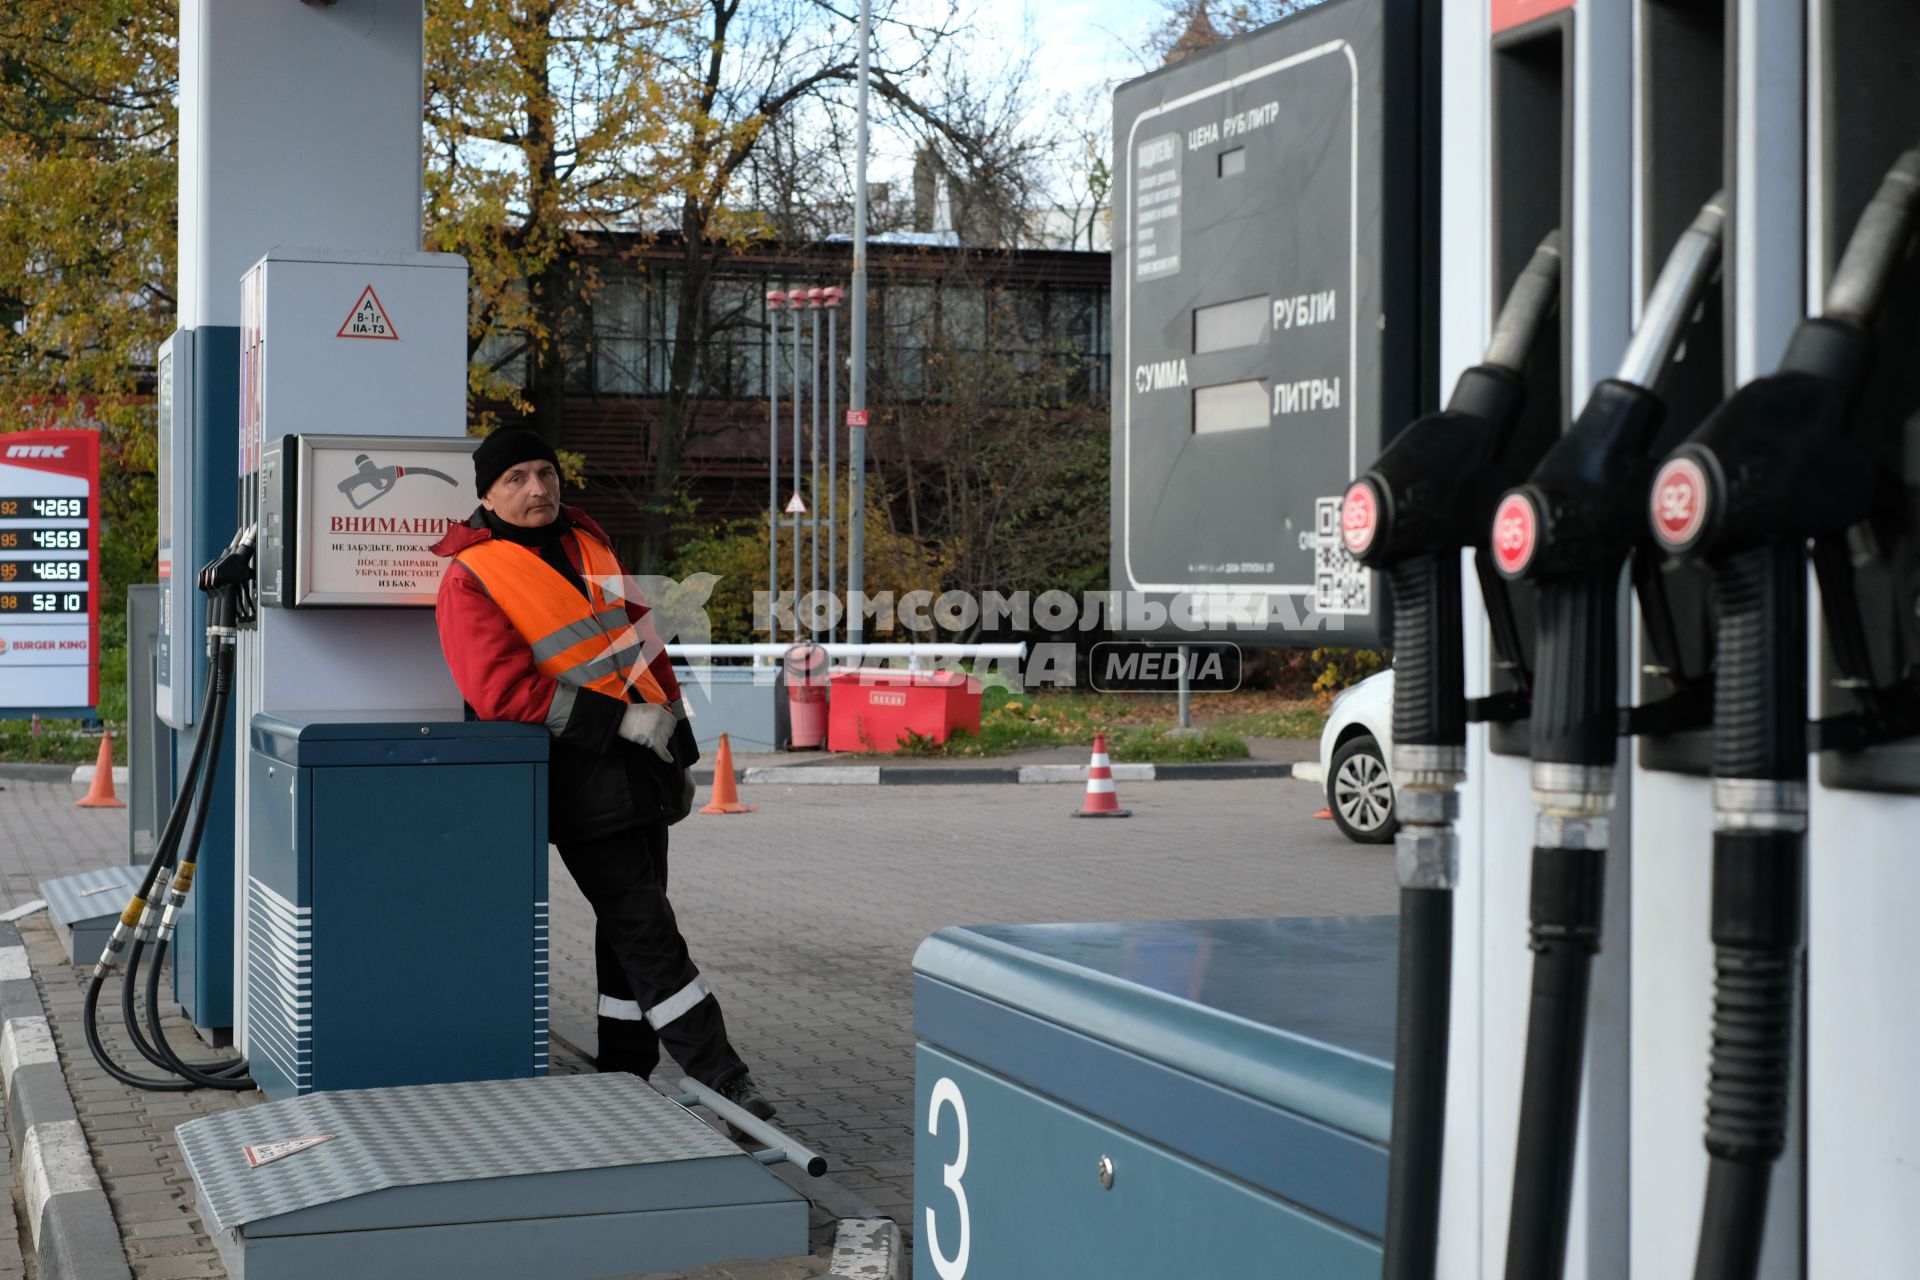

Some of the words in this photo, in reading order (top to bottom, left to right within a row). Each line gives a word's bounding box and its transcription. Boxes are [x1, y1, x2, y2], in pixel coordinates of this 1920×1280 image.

[1188, 122, 1219, 152] ЦЕНА
[1273, 290, 1336, 330] РУБЛИ
[1135, 359, 1189, 393] СУММА
[1273, 377, 1340, 415] ЛИТРЫ
[6, 445, 70, 458] ПТК
[1, 501, 17, 515] 92
[33, 499, 81, 516] 4269
[1662, 484, 1691, 520] 92
[1, 533, 17, 547] 95
[33, 531, 81, 548] 4569
[1502, 517, 1524, 549] 95
[332, 543, 345, 551] НЕ
[357, 559, 390, 567] ПОСЛЕ
[393, 559, 438, 568] ЗАПРАВКИ
[355, 569, 388, 577] УБРАТЬ
[391, 569, 440, 577] ПИСТОЛЕТ
[378, 580, 390, 588] ИЗ
[392, 580, 416, 588] БАКА
[1, 595, 17, 609] 98
[12, 641, 56, 650] BURGER
[59, 641, 87, 650] KING
[926, 1077, 970, 1280] 3
